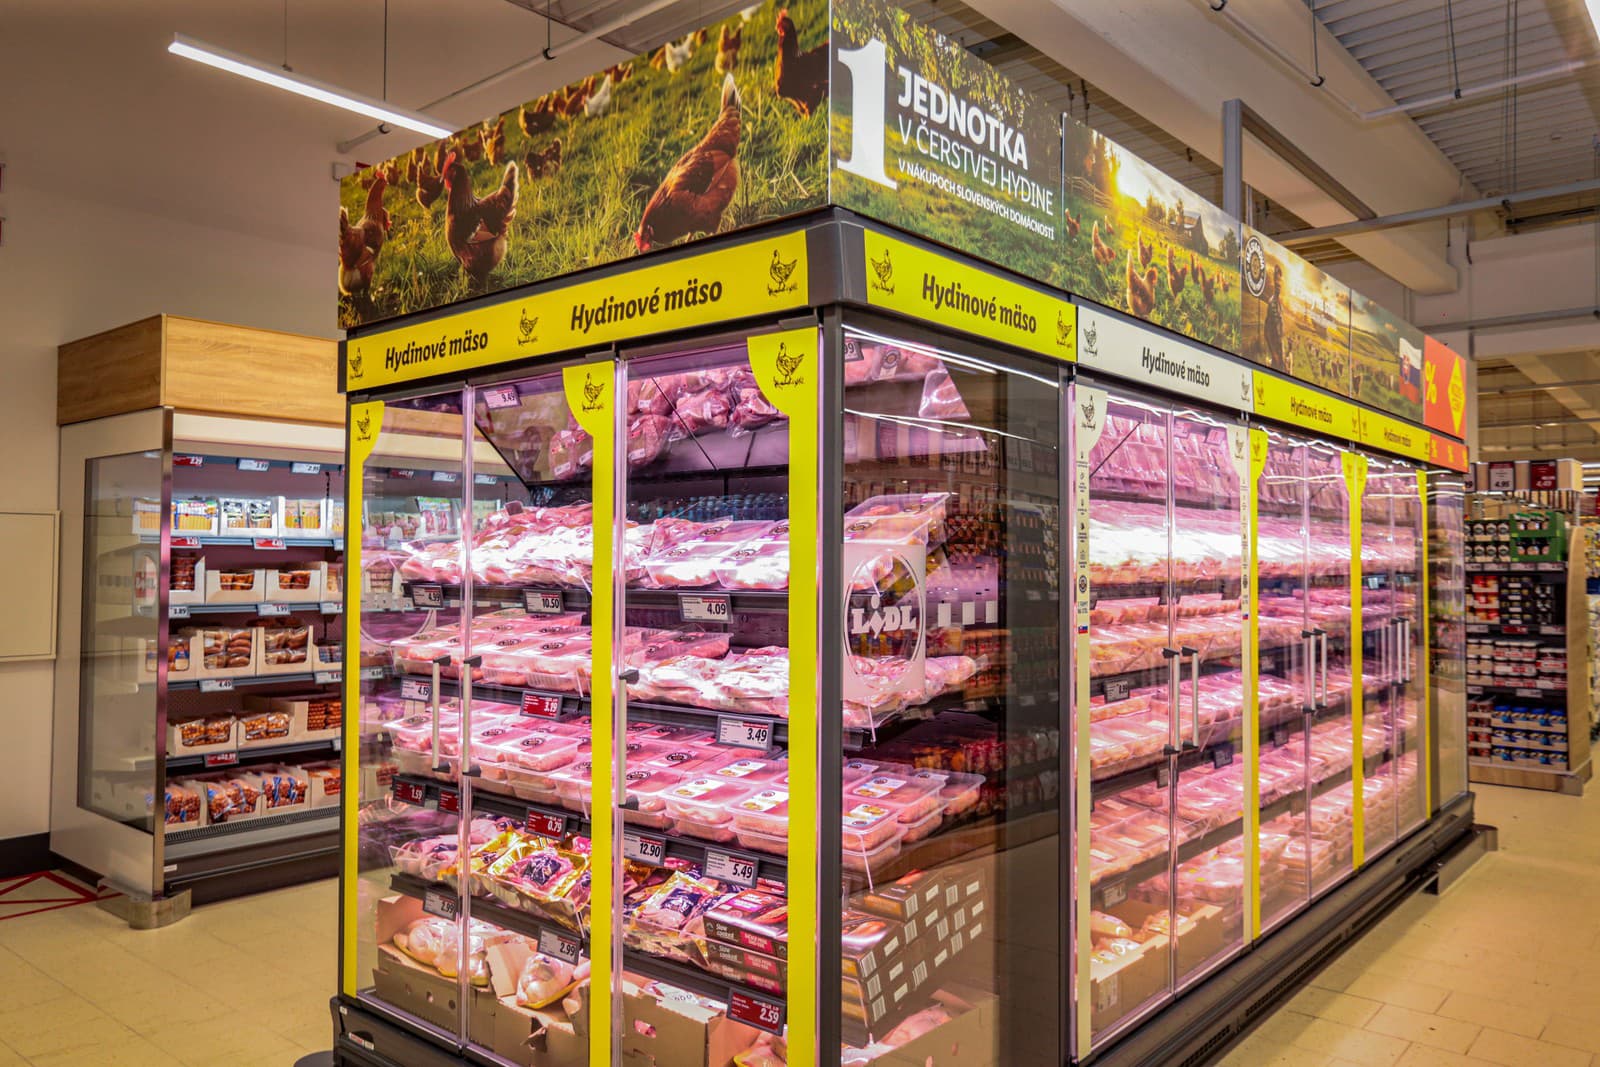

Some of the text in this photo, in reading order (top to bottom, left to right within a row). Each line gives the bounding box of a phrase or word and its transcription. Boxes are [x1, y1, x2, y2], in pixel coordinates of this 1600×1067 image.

[837, 38, 897, 190] 1
[898, 65, 1028, 170] JEDNOTKA
[898, 113, 1054, 216] V ČERSTVEJ HYDINE
[898, 158, 1055, 241] V NÁKUPOCH SLOVENSKÝCH DOMÁCNOSTÍ
[570, 279, 723, 332] Hydinové mäso
[922, 272, 1037, 335] Hydinové mäso
[385, 328, 489, 370] Hydinové mäso
[1141, 347, 1211, 388] Hydinové mäso
[1290, 396, 1333, 424] Hydinové mäso
[541, 598, 560, 609] 10.50
[707, 603, 726, 615] 4.09
[746, 727, 767, 742] 3.49
[547, 820, 562, 833] 0.79
[639, 842, 661, 858] 12.90
[732, 863, 753, 879] 5.49
[441, 900, 455, 914] 2.99
[559, 943, 576, 957] 2.99
[759, 1007, 780, 1024] 2.59
